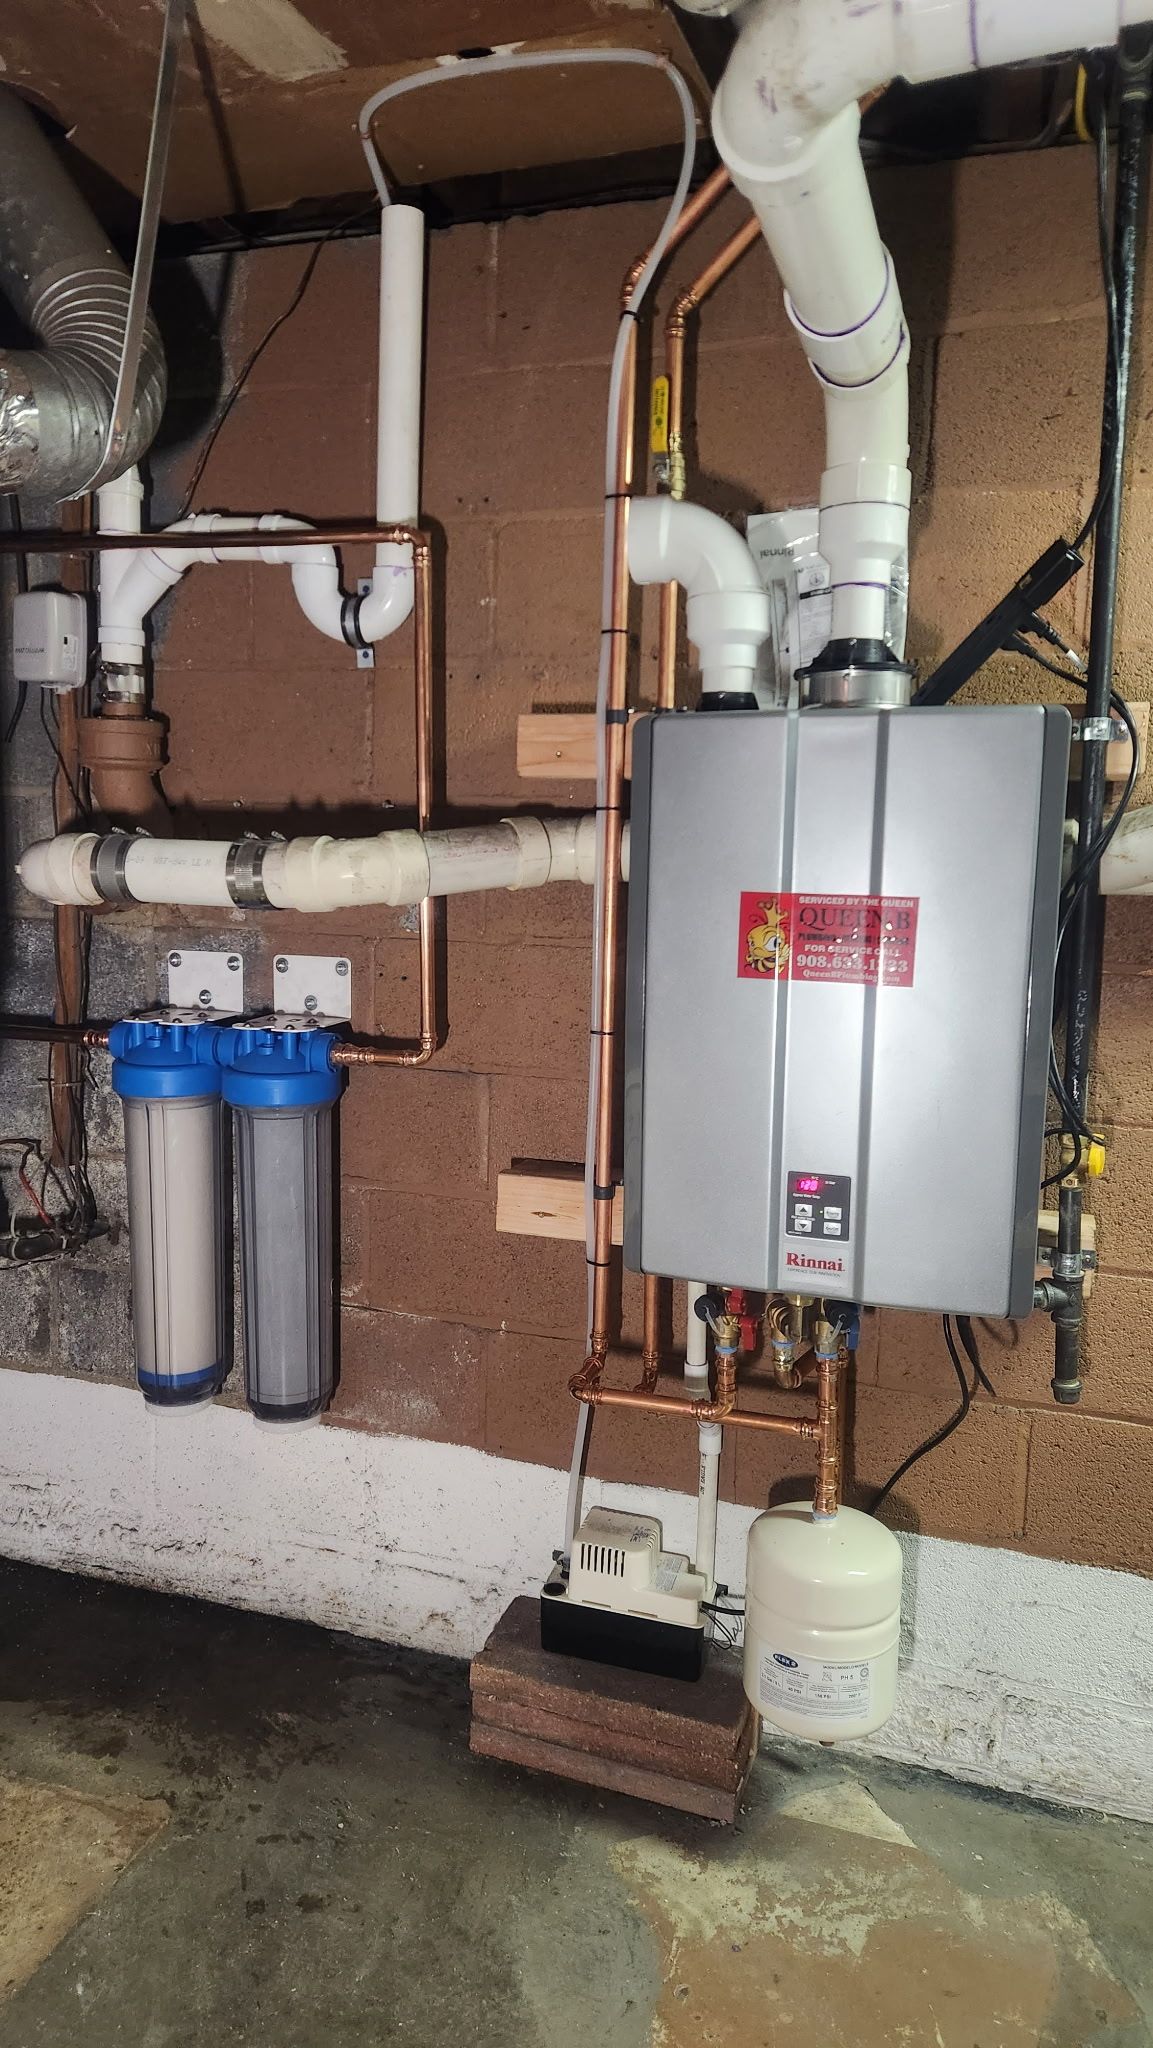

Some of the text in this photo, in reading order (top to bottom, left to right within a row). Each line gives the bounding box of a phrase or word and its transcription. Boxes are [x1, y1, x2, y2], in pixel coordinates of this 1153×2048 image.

[799, 896, 914, 907] SERVICED BY THE QUEEN
[799, 906, 910, 931] QUEEN B
[804, 944, 826, 953] FOR
[827, 945, 873, 955] SERVICE
[786, 1252, 843, 1272] Rinnai
